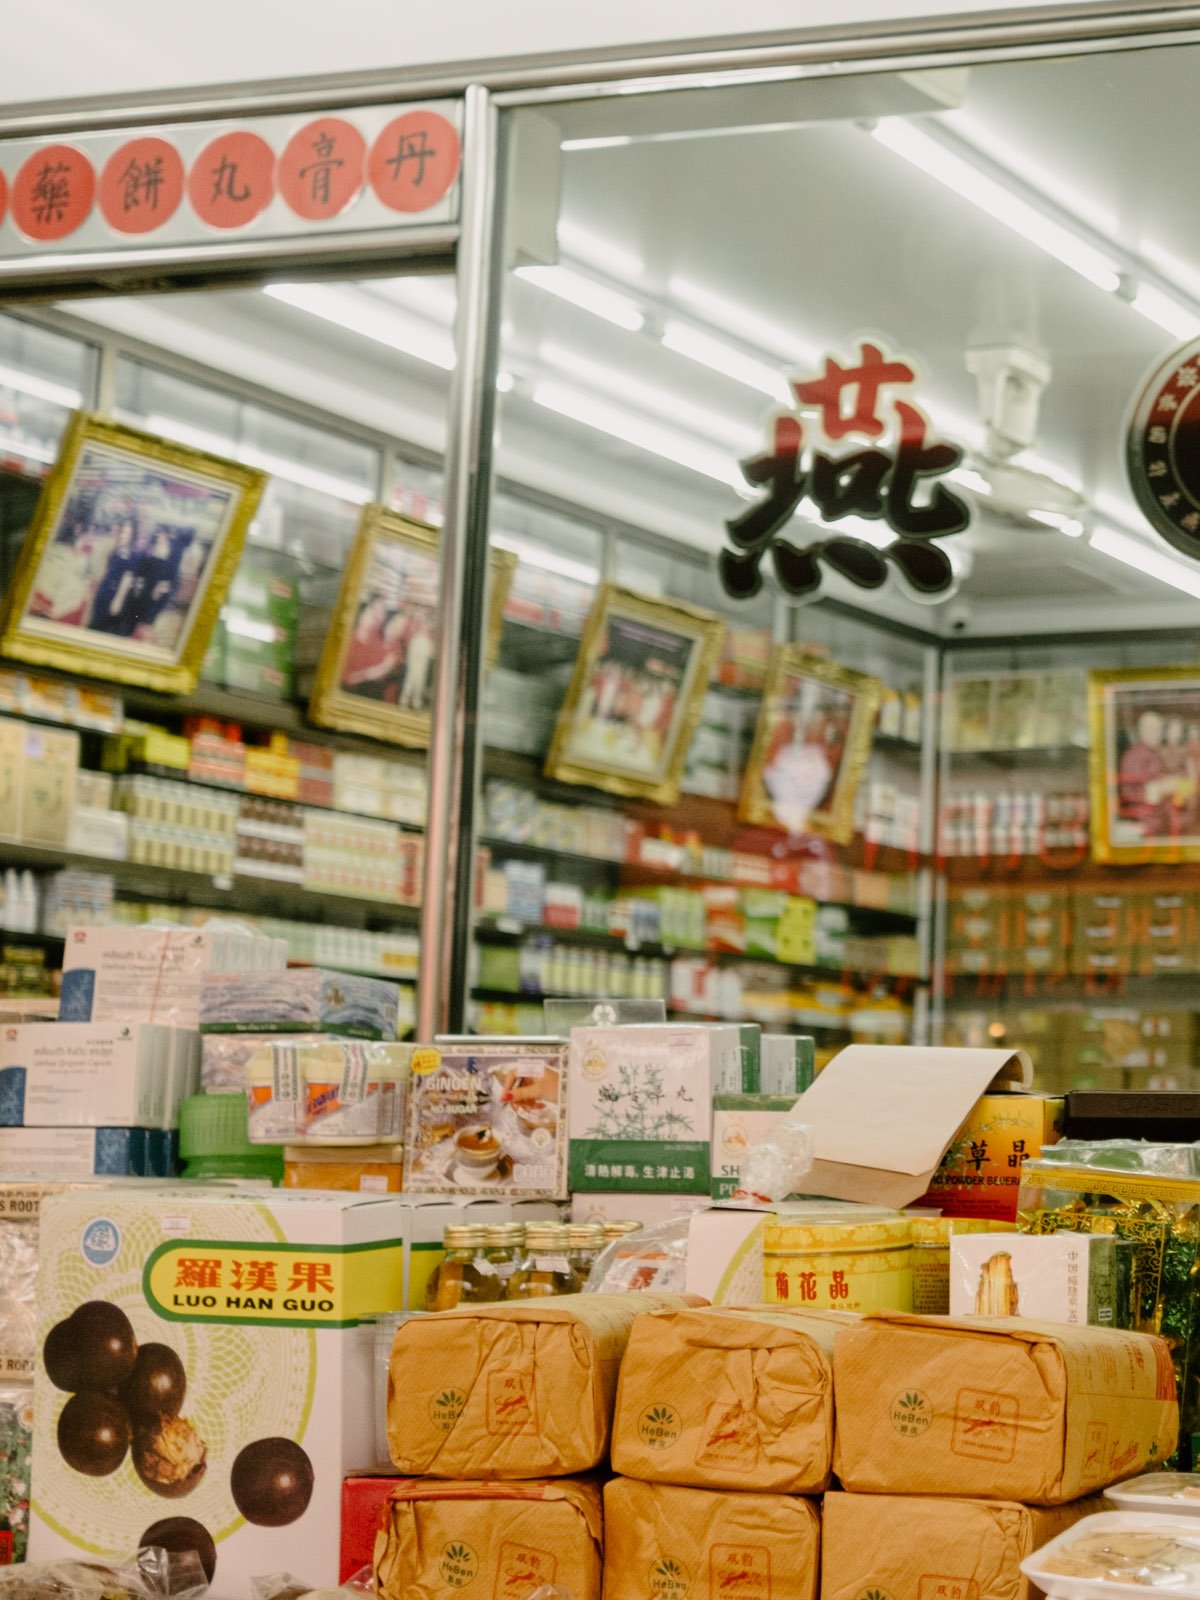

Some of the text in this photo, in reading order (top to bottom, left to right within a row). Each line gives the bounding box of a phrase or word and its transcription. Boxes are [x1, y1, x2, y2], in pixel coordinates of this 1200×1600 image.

[718, 343, 970, 599] 燕
[945, 1176, 985, 1186] POWDER
[174, 1258, 335, 1294] 羅漢果
[776, 1269, 849, 1301] 菊花晶
[173, 1294, 335, 1318] LUO HAN GUO
[893, 1411, 929, 1426] HeBen
[641, 1424, 678, 1439] HeBen
[442, 1561, 474, 1578] HeBen
[653, 1578, 687, 1590] HeBen
